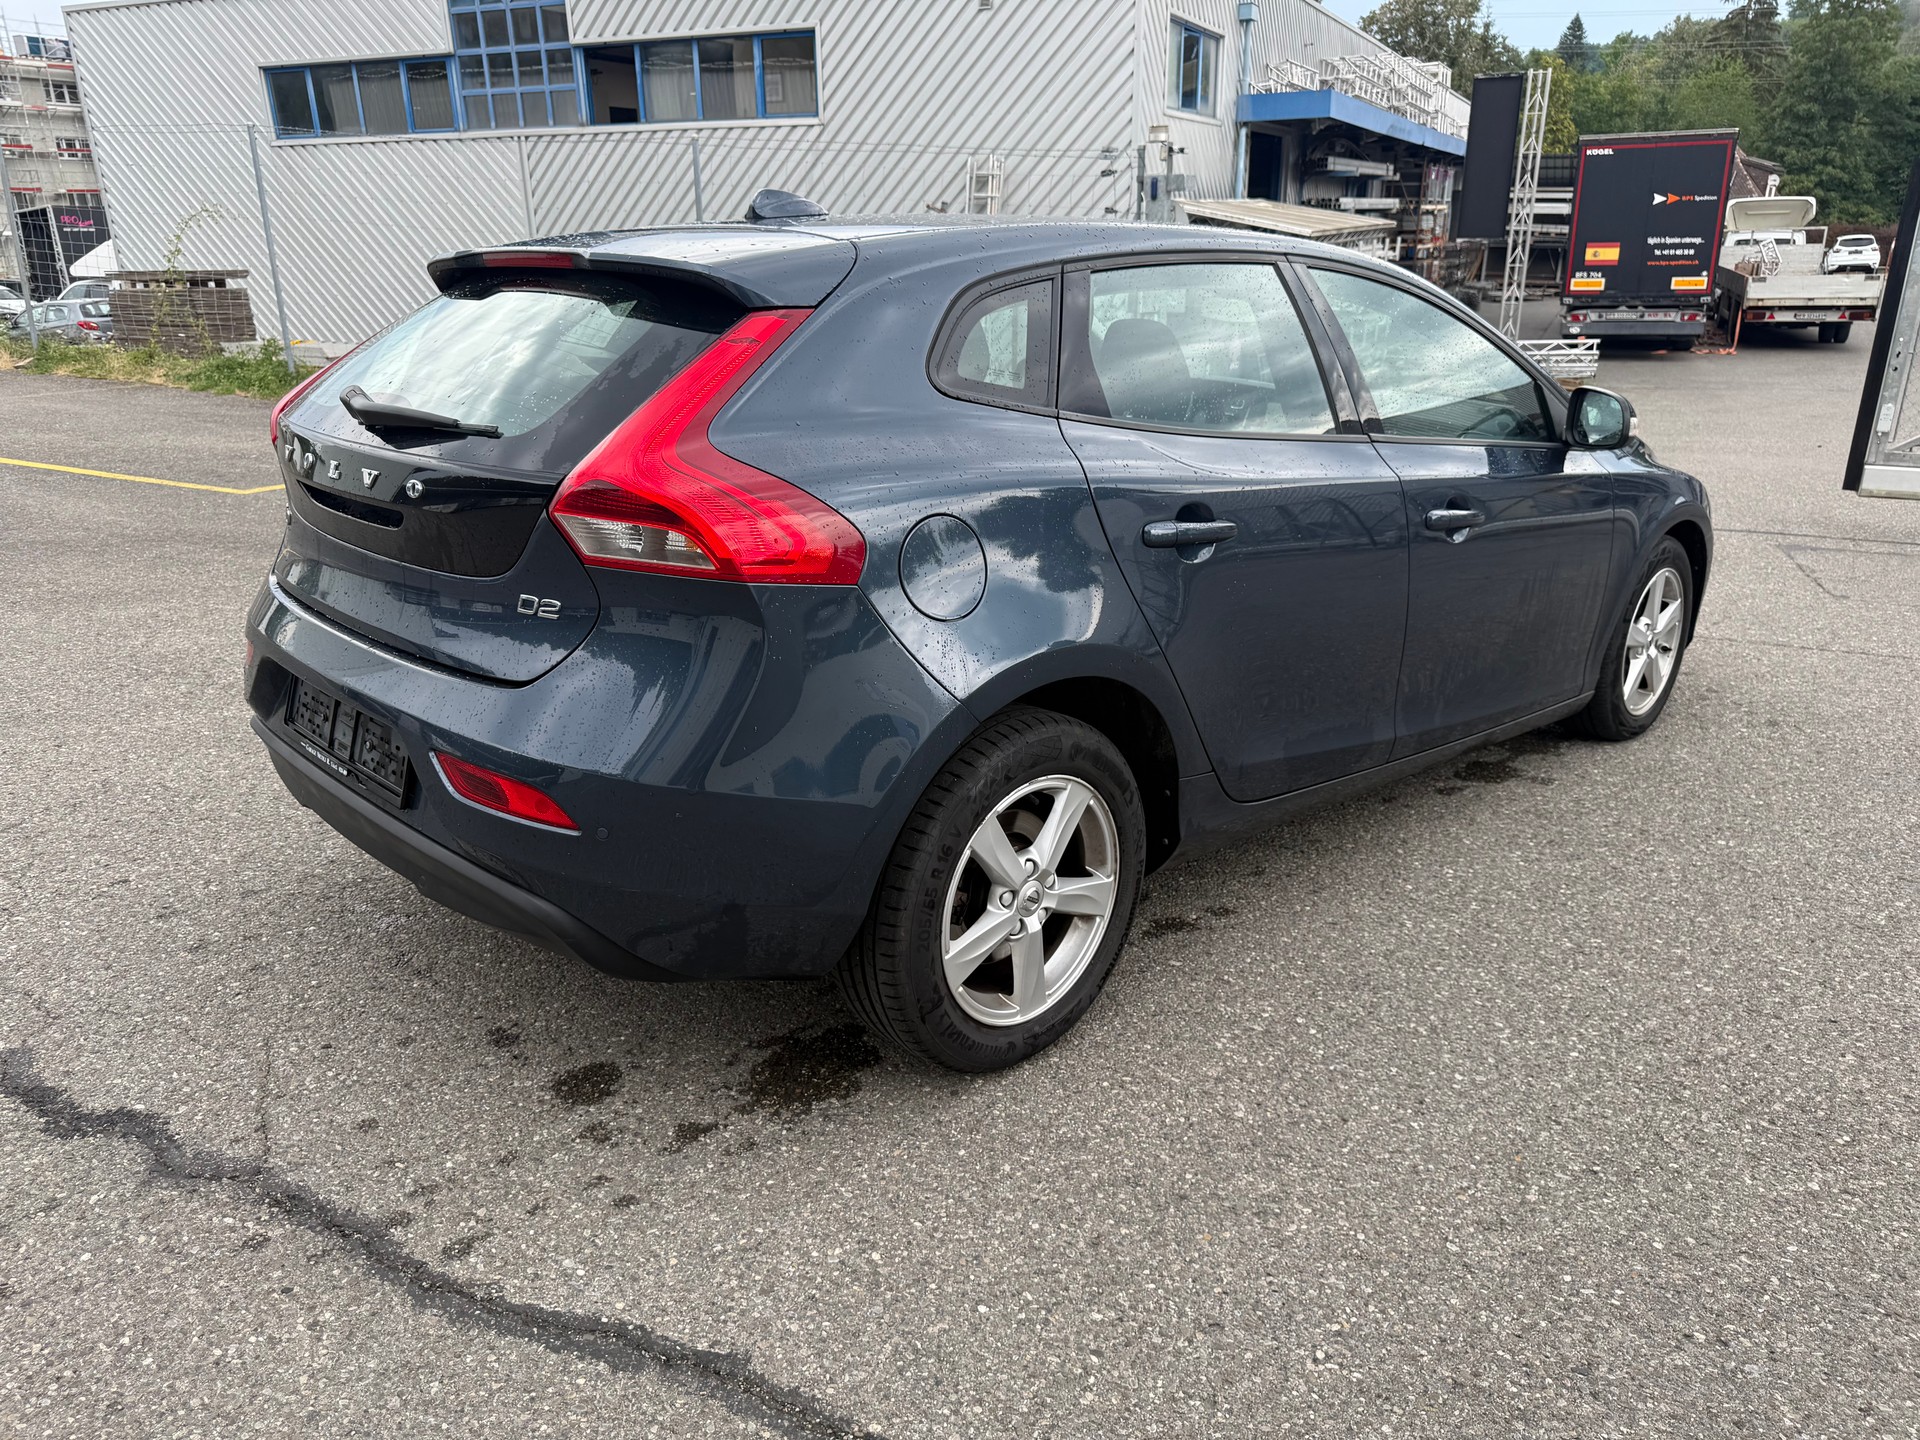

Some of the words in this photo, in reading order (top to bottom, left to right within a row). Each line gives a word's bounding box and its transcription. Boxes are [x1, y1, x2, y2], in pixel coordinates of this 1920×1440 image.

[1694, 194, 1718, 202] Spedition
[284, 444, 425, 499] VOLVO
[517, 594, 561, 620] D2
